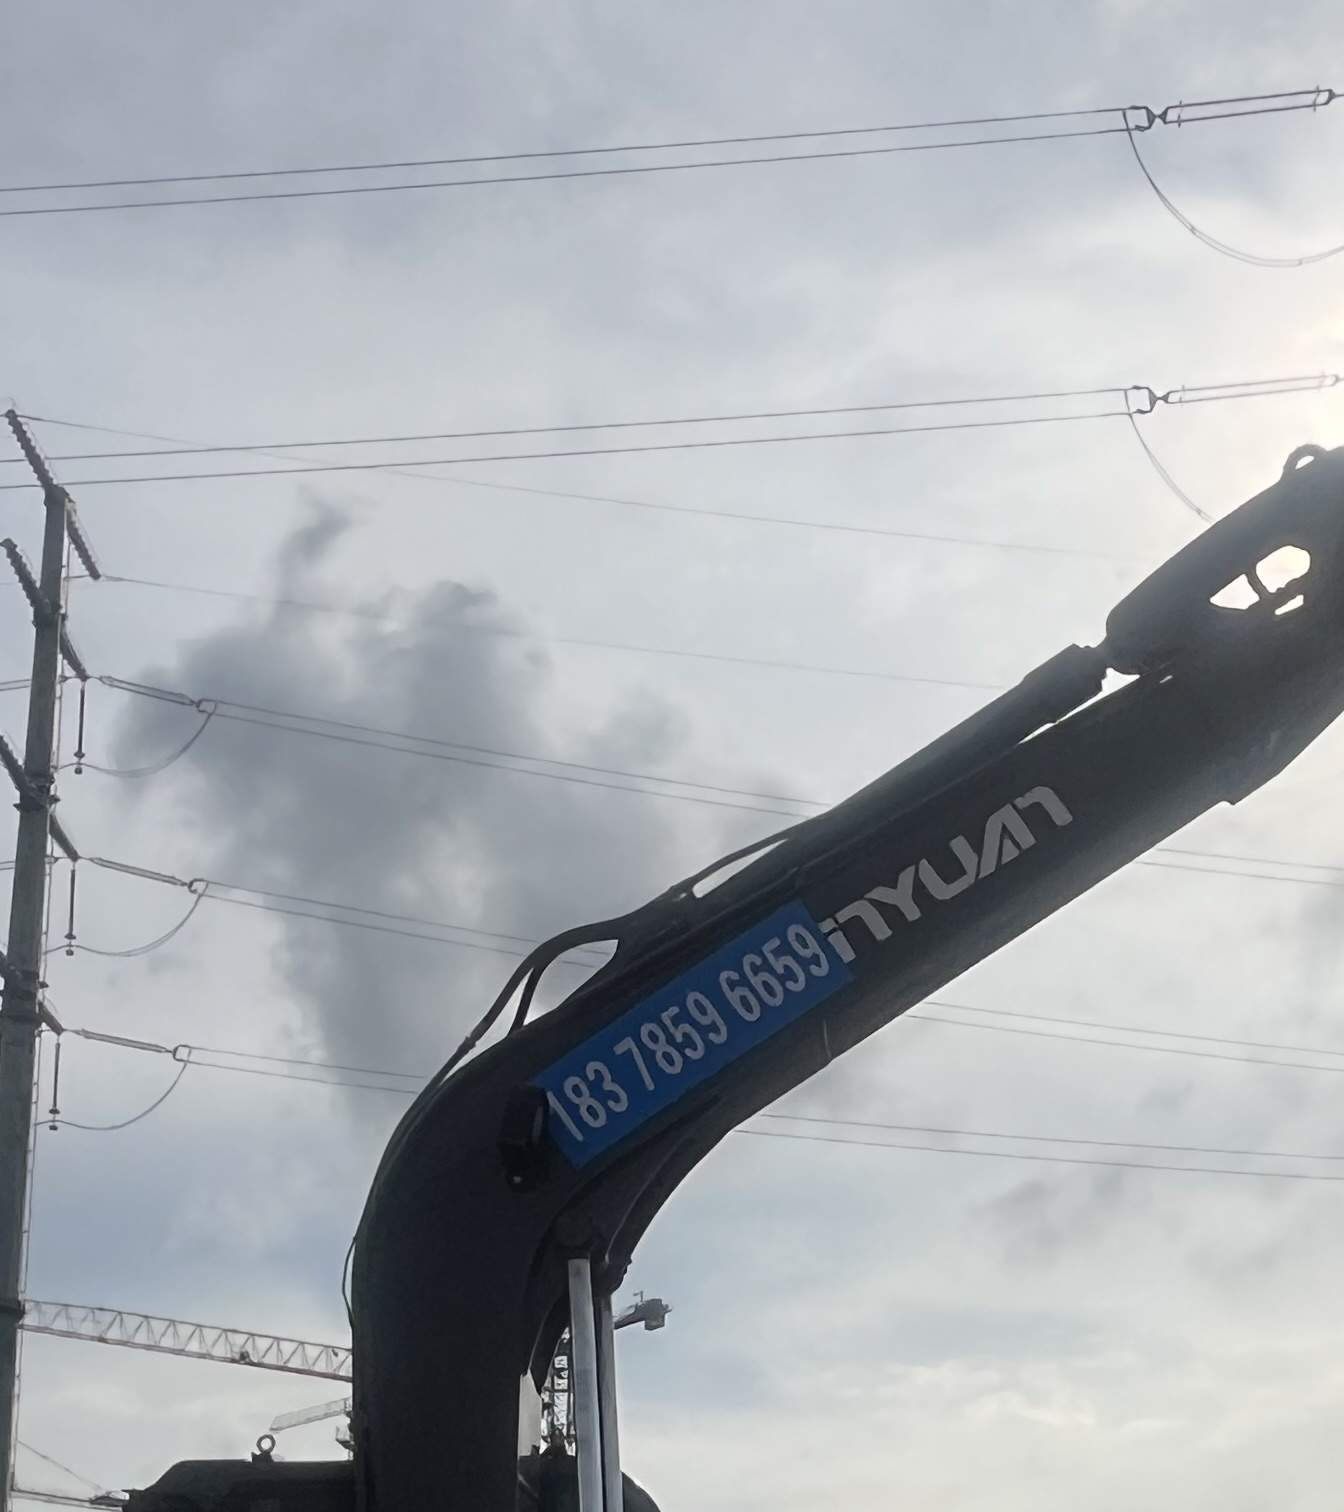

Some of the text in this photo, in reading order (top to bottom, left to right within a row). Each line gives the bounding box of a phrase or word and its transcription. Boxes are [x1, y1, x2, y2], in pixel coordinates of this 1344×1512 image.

[818, 786, 1073, 963] INYUAN
[546, 924, 829, 1142] 183 7859 6659
